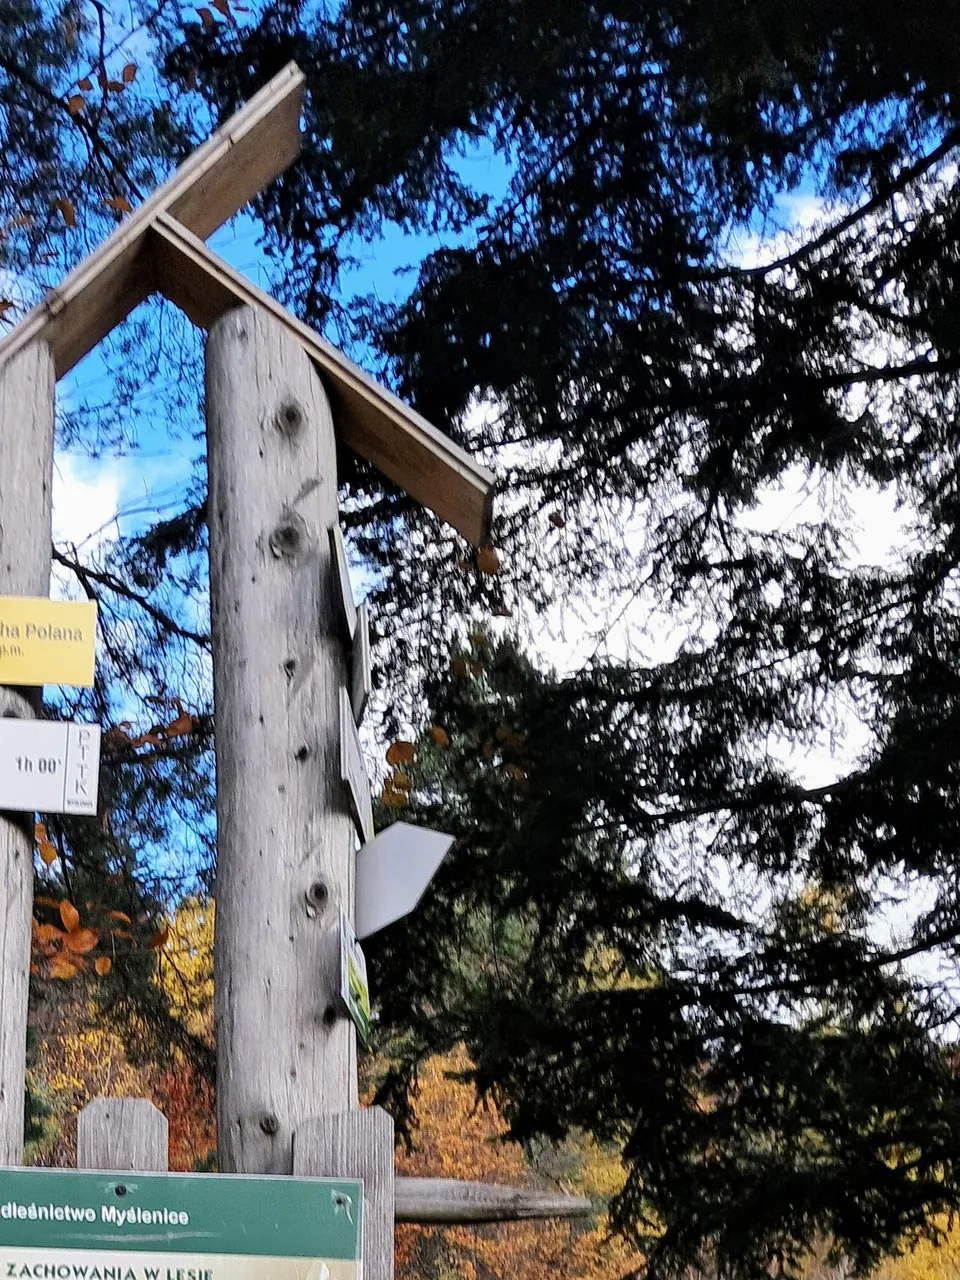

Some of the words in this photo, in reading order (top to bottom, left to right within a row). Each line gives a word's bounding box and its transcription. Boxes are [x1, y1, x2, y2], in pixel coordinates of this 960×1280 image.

[25, 625, 83, 642] Polana
[14, 756, 33, 774] 1h
[101, 1205, 189, 1227] Myślenice
